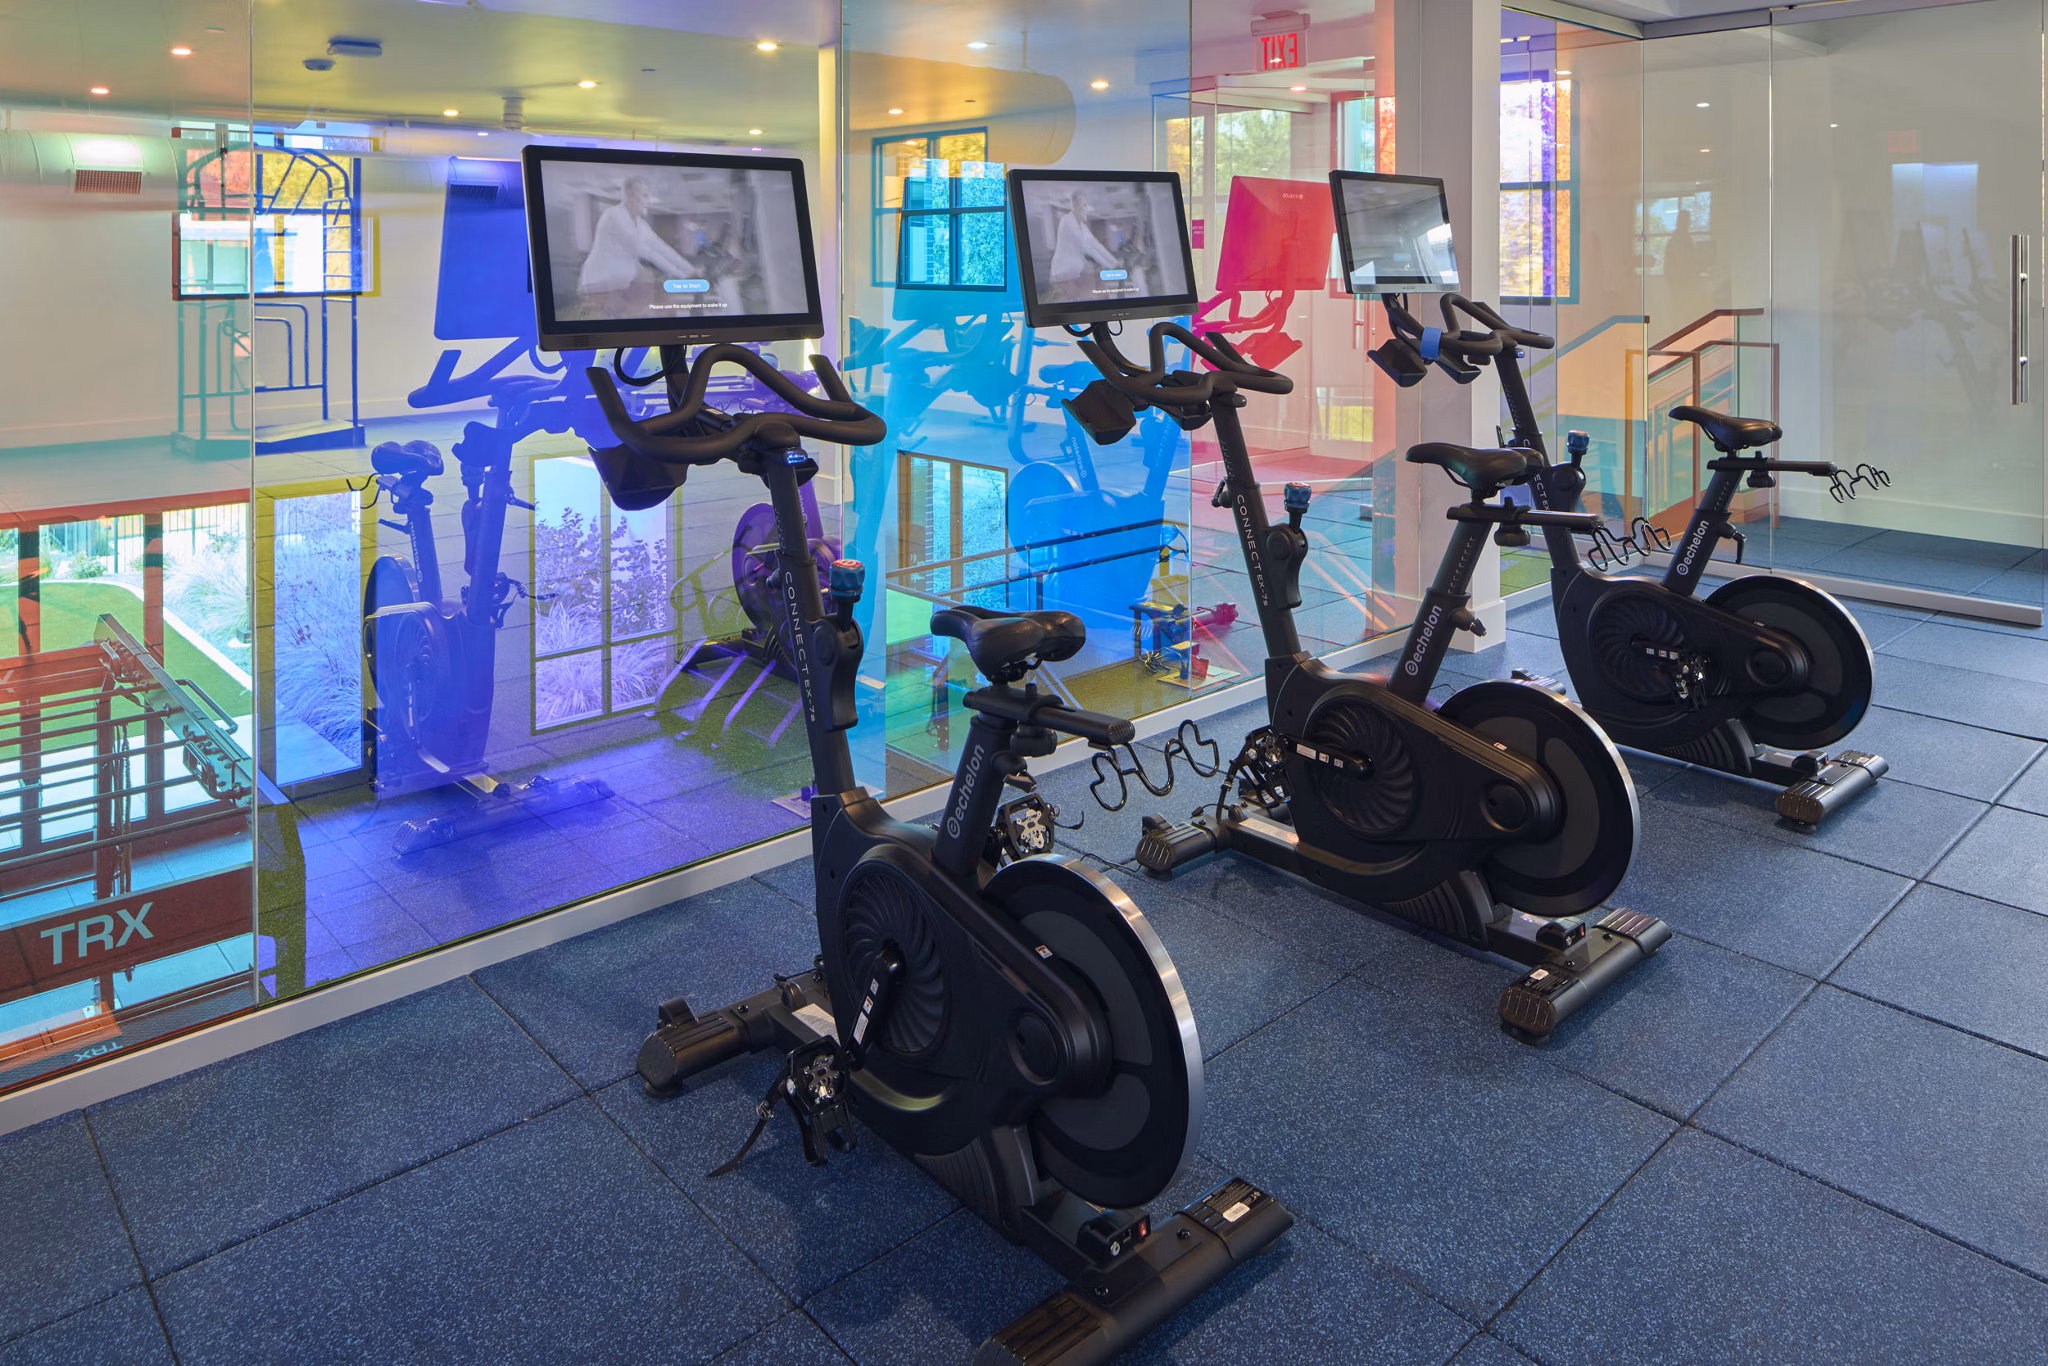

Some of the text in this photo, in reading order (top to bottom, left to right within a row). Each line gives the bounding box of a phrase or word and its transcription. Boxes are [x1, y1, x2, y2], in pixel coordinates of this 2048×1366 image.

[1237, 494, 1262, 571] CONNECT
[1684, 520, 1709, 568] echelon
[785, 571, 809, 675] CONNECT
[1413, 605, 1442, 663] echelon
[955, 744, 985, 821] echelon
[40, 901, 154, 965] TRX
